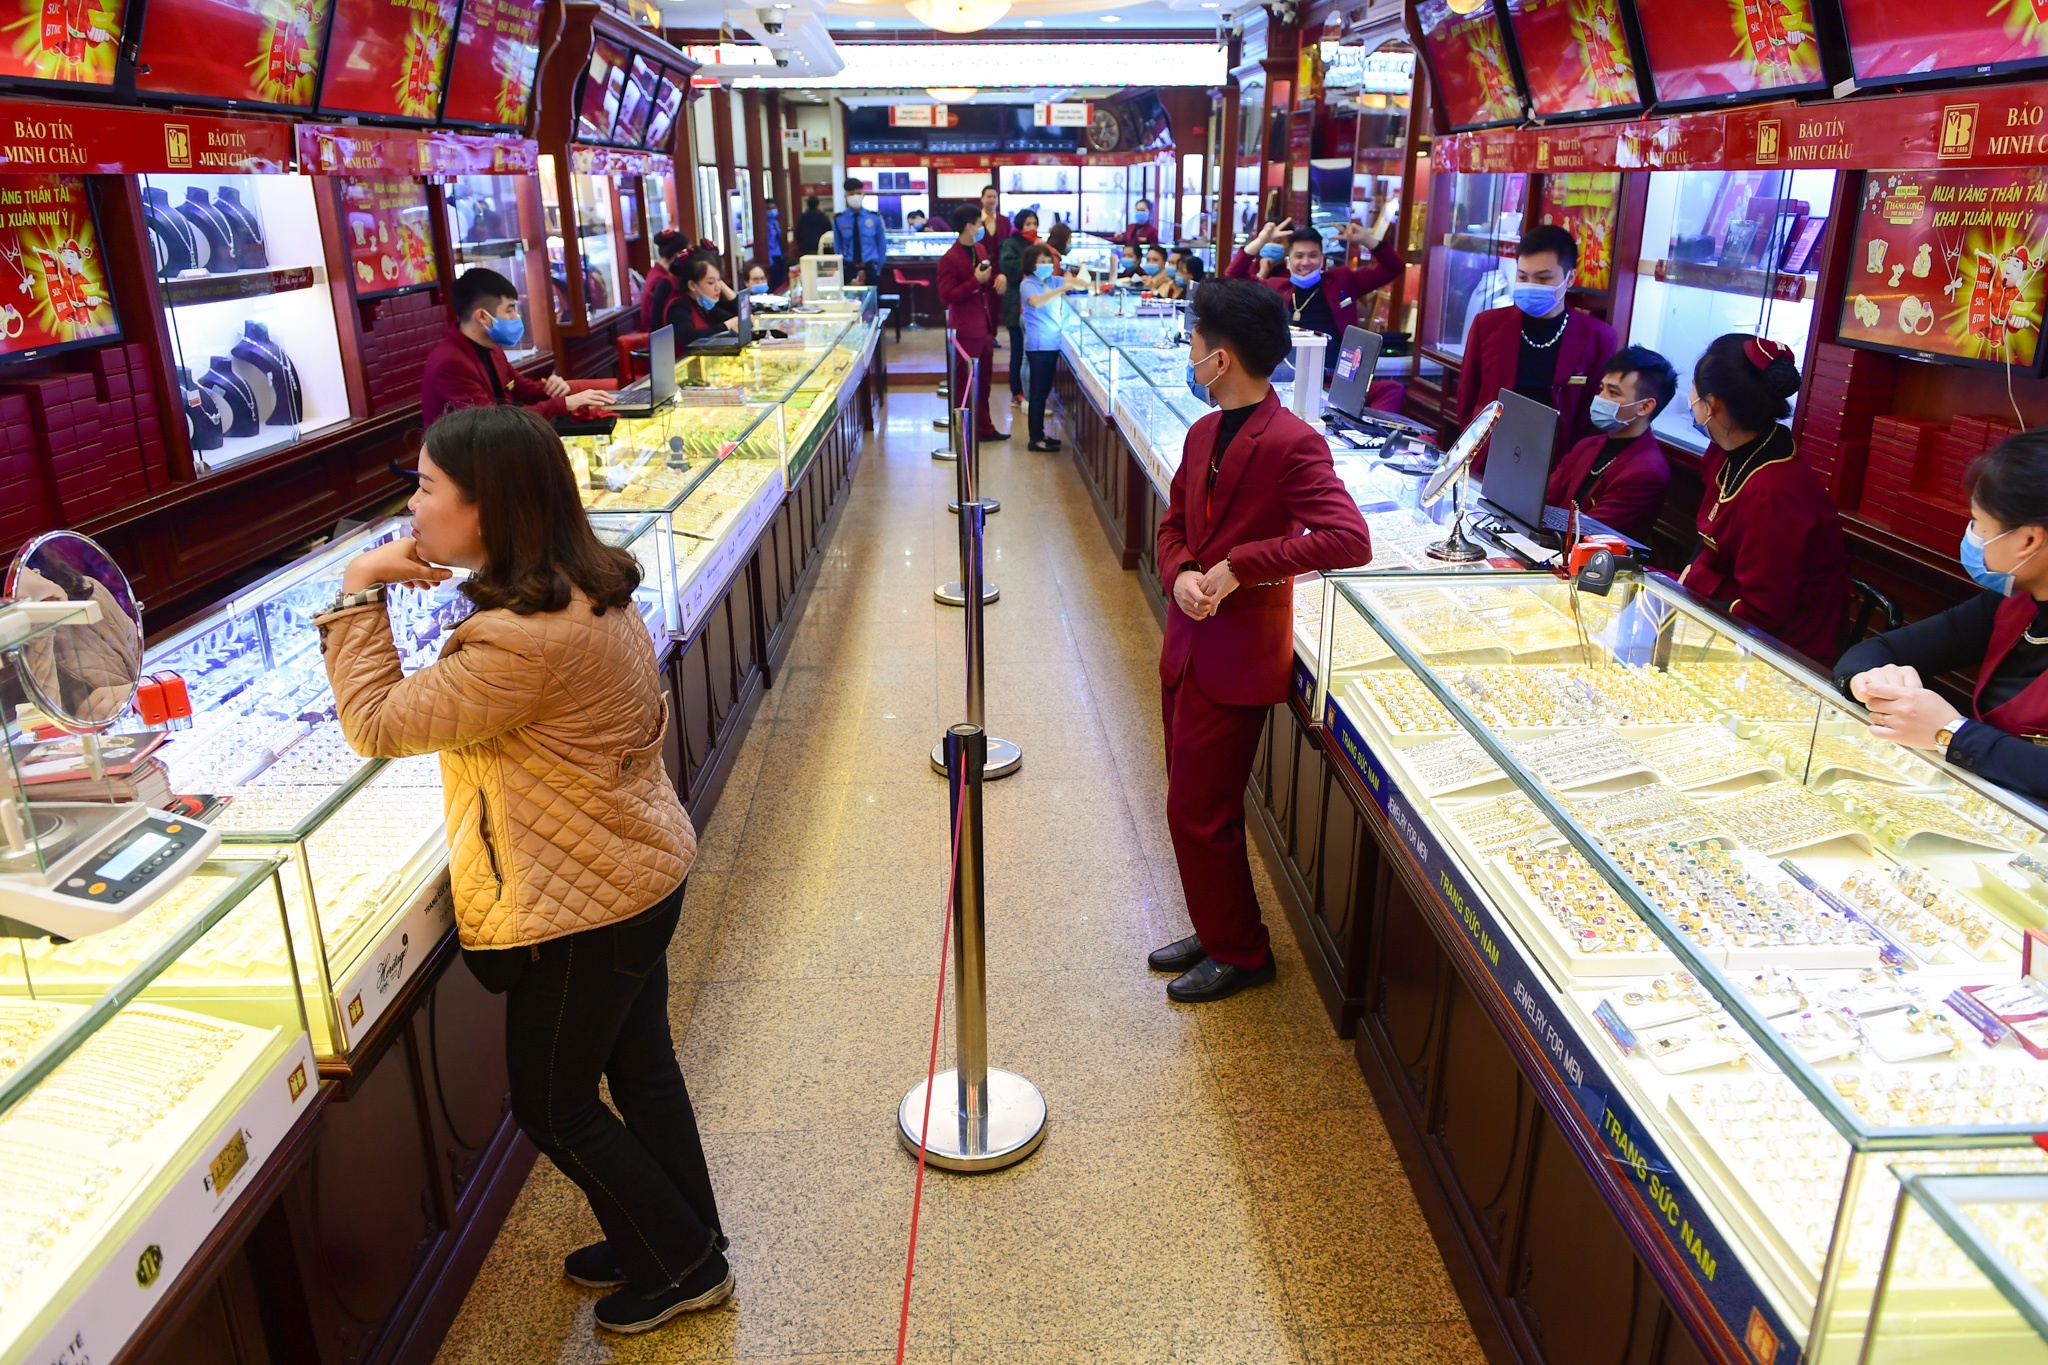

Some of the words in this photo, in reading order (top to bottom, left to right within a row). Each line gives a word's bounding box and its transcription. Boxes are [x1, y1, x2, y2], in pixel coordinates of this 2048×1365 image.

[2006, 101, 2044, 127] BẢO
[14, 117, 47, 139] BẢO
[48, 119, 74, 140] TÍN
[208, 129, 228, 146] BẢO
[231, 129, 246, 147] TÍN
[1799, 118, 1822, 138] BẢO
[1825, 116, 1845, 137] TÍN
[4, 145, 46, 163] MINH
[49, 143, 87, 164] CHÂU
[1788, 145, 1818, 161] MINH
[1820, 139, 1853, 160] CHÂU
[1987, 135, 2035, 155] MINH
[200, 152, 227, 166] MINH
[54, 184, 70, 203] TÀI
[1930, 185, 1955, 202] MUA
[1958, 184, 1988, 202] VÀNG
[2025, 180, 2048, 202] TÀI
[1906, 201, 1924, 211] LONG
[8, 209, 36, 227] XUÂN
[39, 210, 60, 226] NHƯ
[1932, 211, 1960, 228] KHAI
[1961, 208, 1993, 226] XUÂN
[1994, 210, 2024, 229] NHƯ
[1342, 729, 1358, 761] TRANG
[1357, 751, 1369, 776] SỨC
[1368, 766, 1380, 793] NAM
[1387, 796, 1408, 832] JEWELRY
[1407, 824, 1417, 844] FOR
[1416, 836, 1429, 863] MEN
[1440, 869, 1464, 916] TRANG
[1464, 907, 1480, 939] SỨC
[1481, 930, 1500, 967] NAM
[1513, 980, 1548, 1036] JEWELRY
[1546, 1023, 1564, 1061] FOR
[1564, 1052, 1584, 1090] MEN
[1605, 1107, 1648, 1183] TRANG
[1649, 1176, 1680, 1227] SỨC
[1680, 1219, 1717, 1283] NAM
